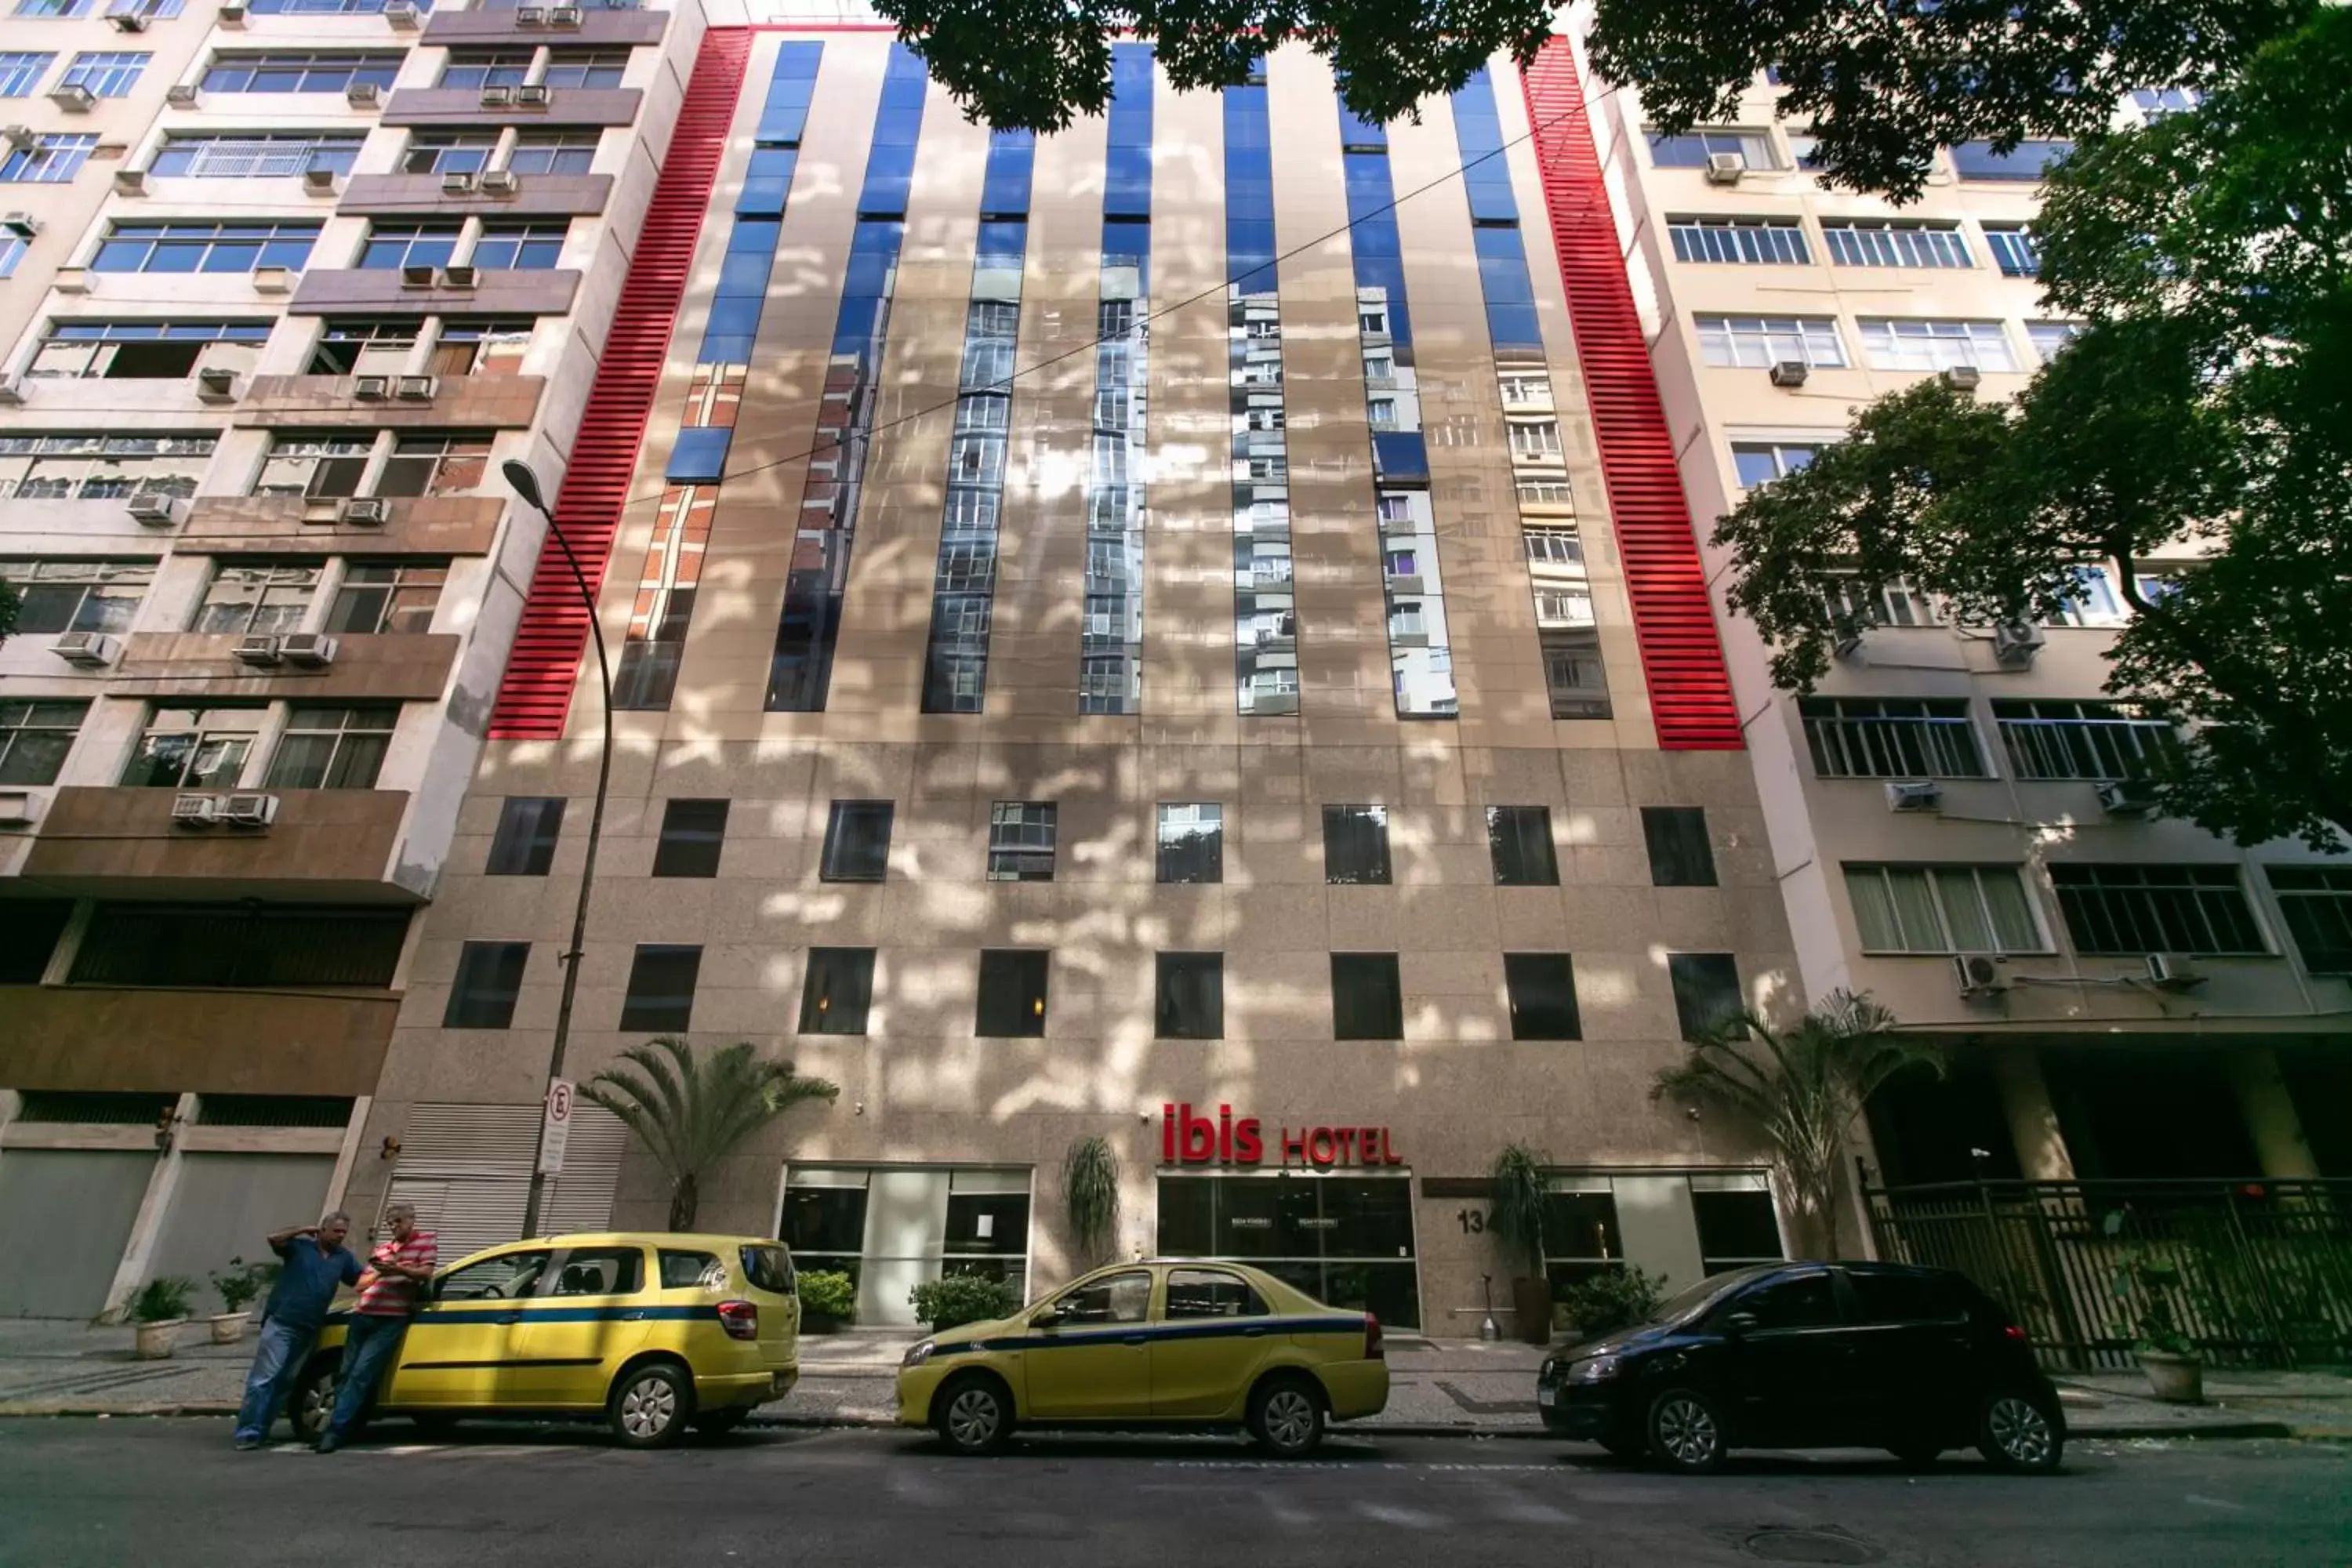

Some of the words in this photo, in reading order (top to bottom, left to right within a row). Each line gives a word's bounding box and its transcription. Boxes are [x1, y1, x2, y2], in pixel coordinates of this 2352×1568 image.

[1163, 1103, 1263, 1162] ibis
[1281, 1127, 1403, 1164] HOTEL
[1457, 1210, 1495, 1234] 13
